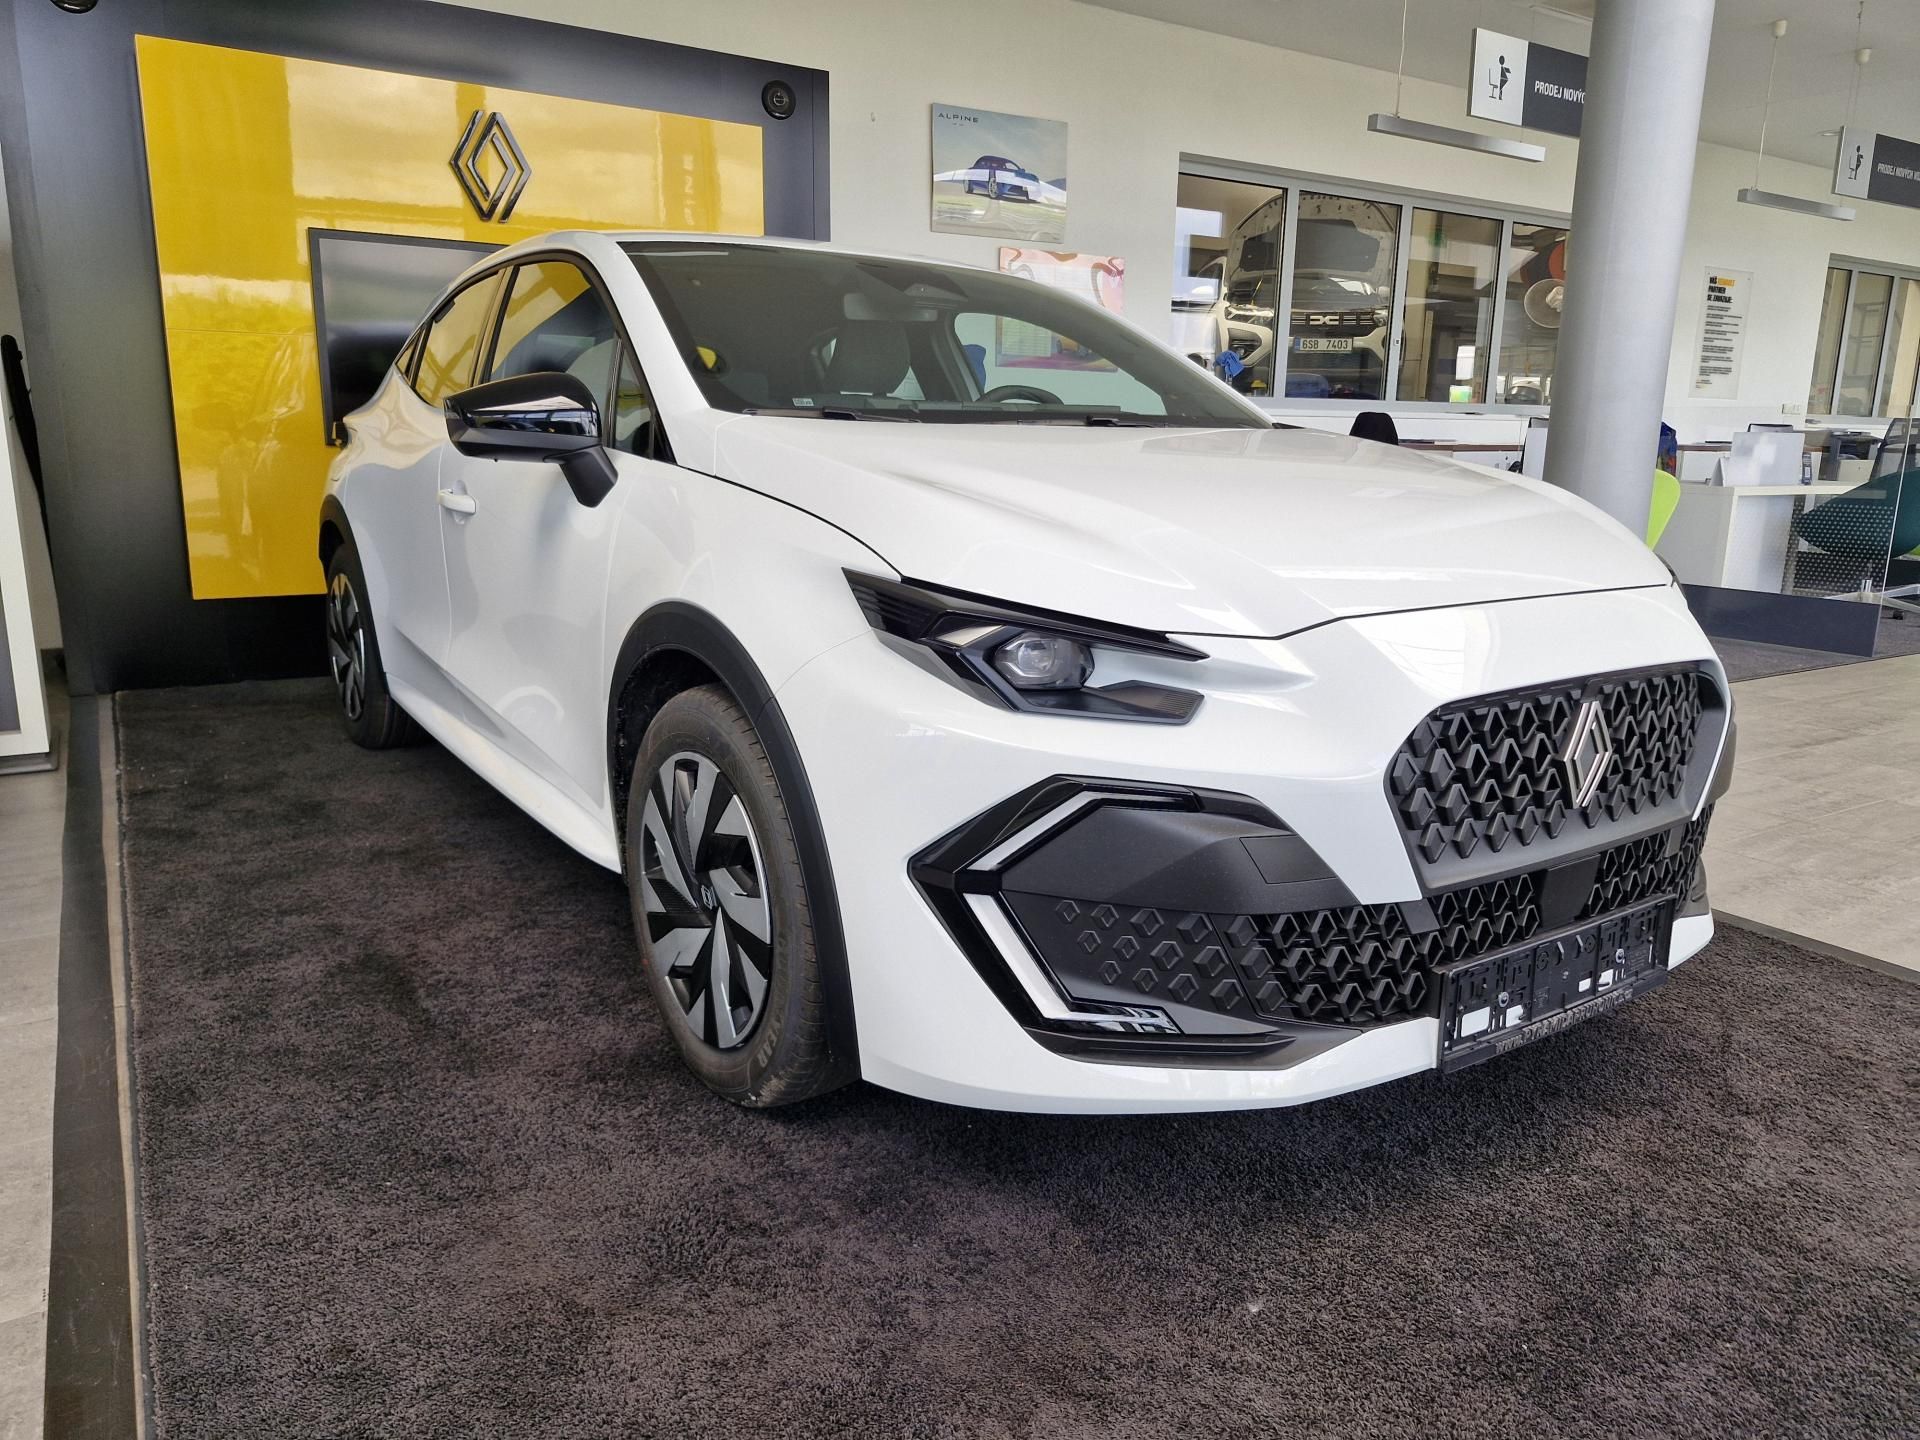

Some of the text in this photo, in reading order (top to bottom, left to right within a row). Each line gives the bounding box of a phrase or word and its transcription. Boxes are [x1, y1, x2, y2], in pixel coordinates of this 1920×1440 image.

[1534, 80, 1562, 98] PRODEJ
[938, 112, 979, 123] ALPINE
[1302, 340, 1349, 350] 6SB 7403
